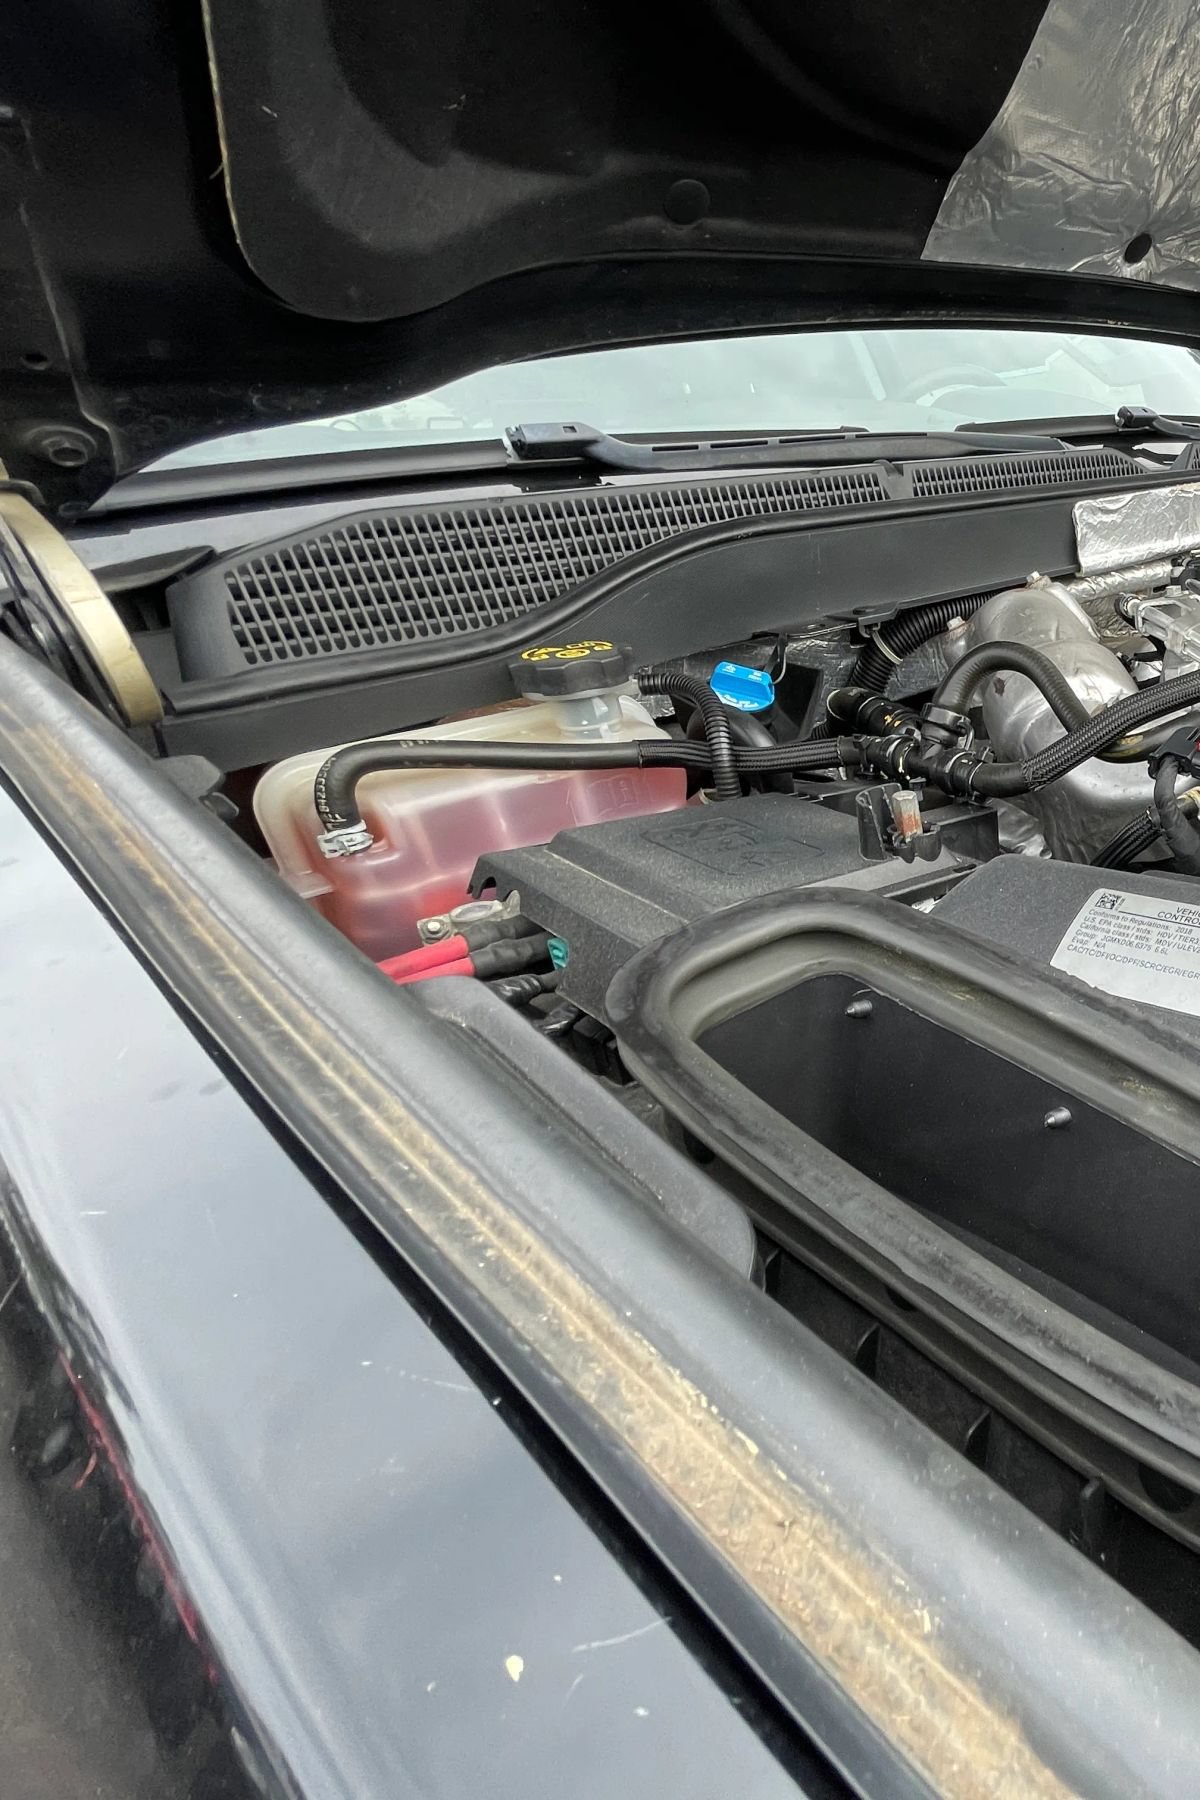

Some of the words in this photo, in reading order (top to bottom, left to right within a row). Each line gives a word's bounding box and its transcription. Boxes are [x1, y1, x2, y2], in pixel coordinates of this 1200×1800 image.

[1080, 921, 1111, 934] California
[1112, 928, 1130, 939] class
[1155, 938, 1172, 948] MDV
[1088, 908, 1120, 921] Conforms
[1175, 926, 1193, 936] 2018
[1098, 918, 1112, 928] EPA
[1113, 922, 1131, 931] class
[1156, 931, 1173, 940] HDV
